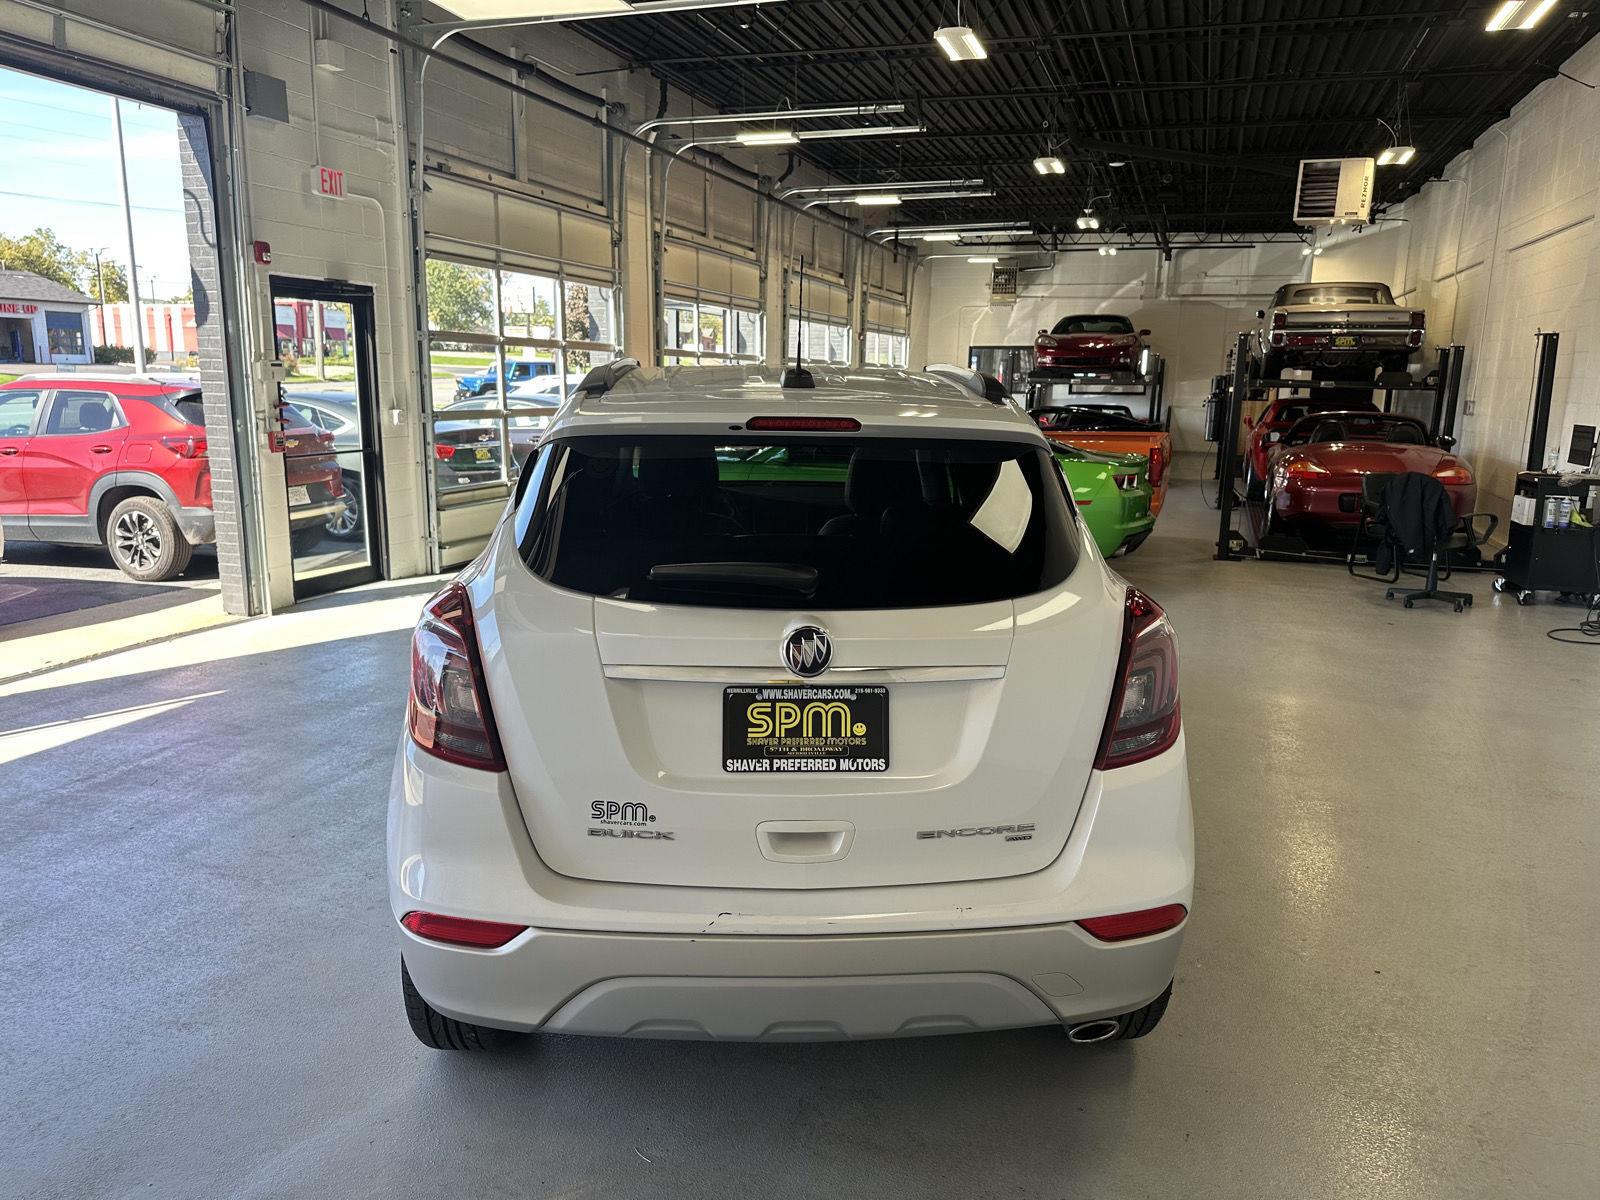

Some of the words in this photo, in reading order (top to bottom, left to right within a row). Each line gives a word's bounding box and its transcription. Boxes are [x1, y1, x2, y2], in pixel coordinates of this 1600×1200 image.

[320, 167, 344, 197] EXIT
[1360, 176, 1369, 208] REZNOR
[762, 688, 851, 700] WWW.SHAVERCARS.COM
[746, 737, 779, 746] SHAVER
[781, 737, 826, 746] PREFERRED
[827, 737, 867, 746] MOTORS
[726, 759, 770, 771] SHAVER
[773, 759, 837, 771] PREFERRED
[840, 758, 886, 771] MOTORS
[600, 819, 647, 827] shavercars.com
[587, 827, 676, 841] BUICK
[916, 822, 1036, 840] ENCORE
[1005, 834, 1032, 842] AWD
